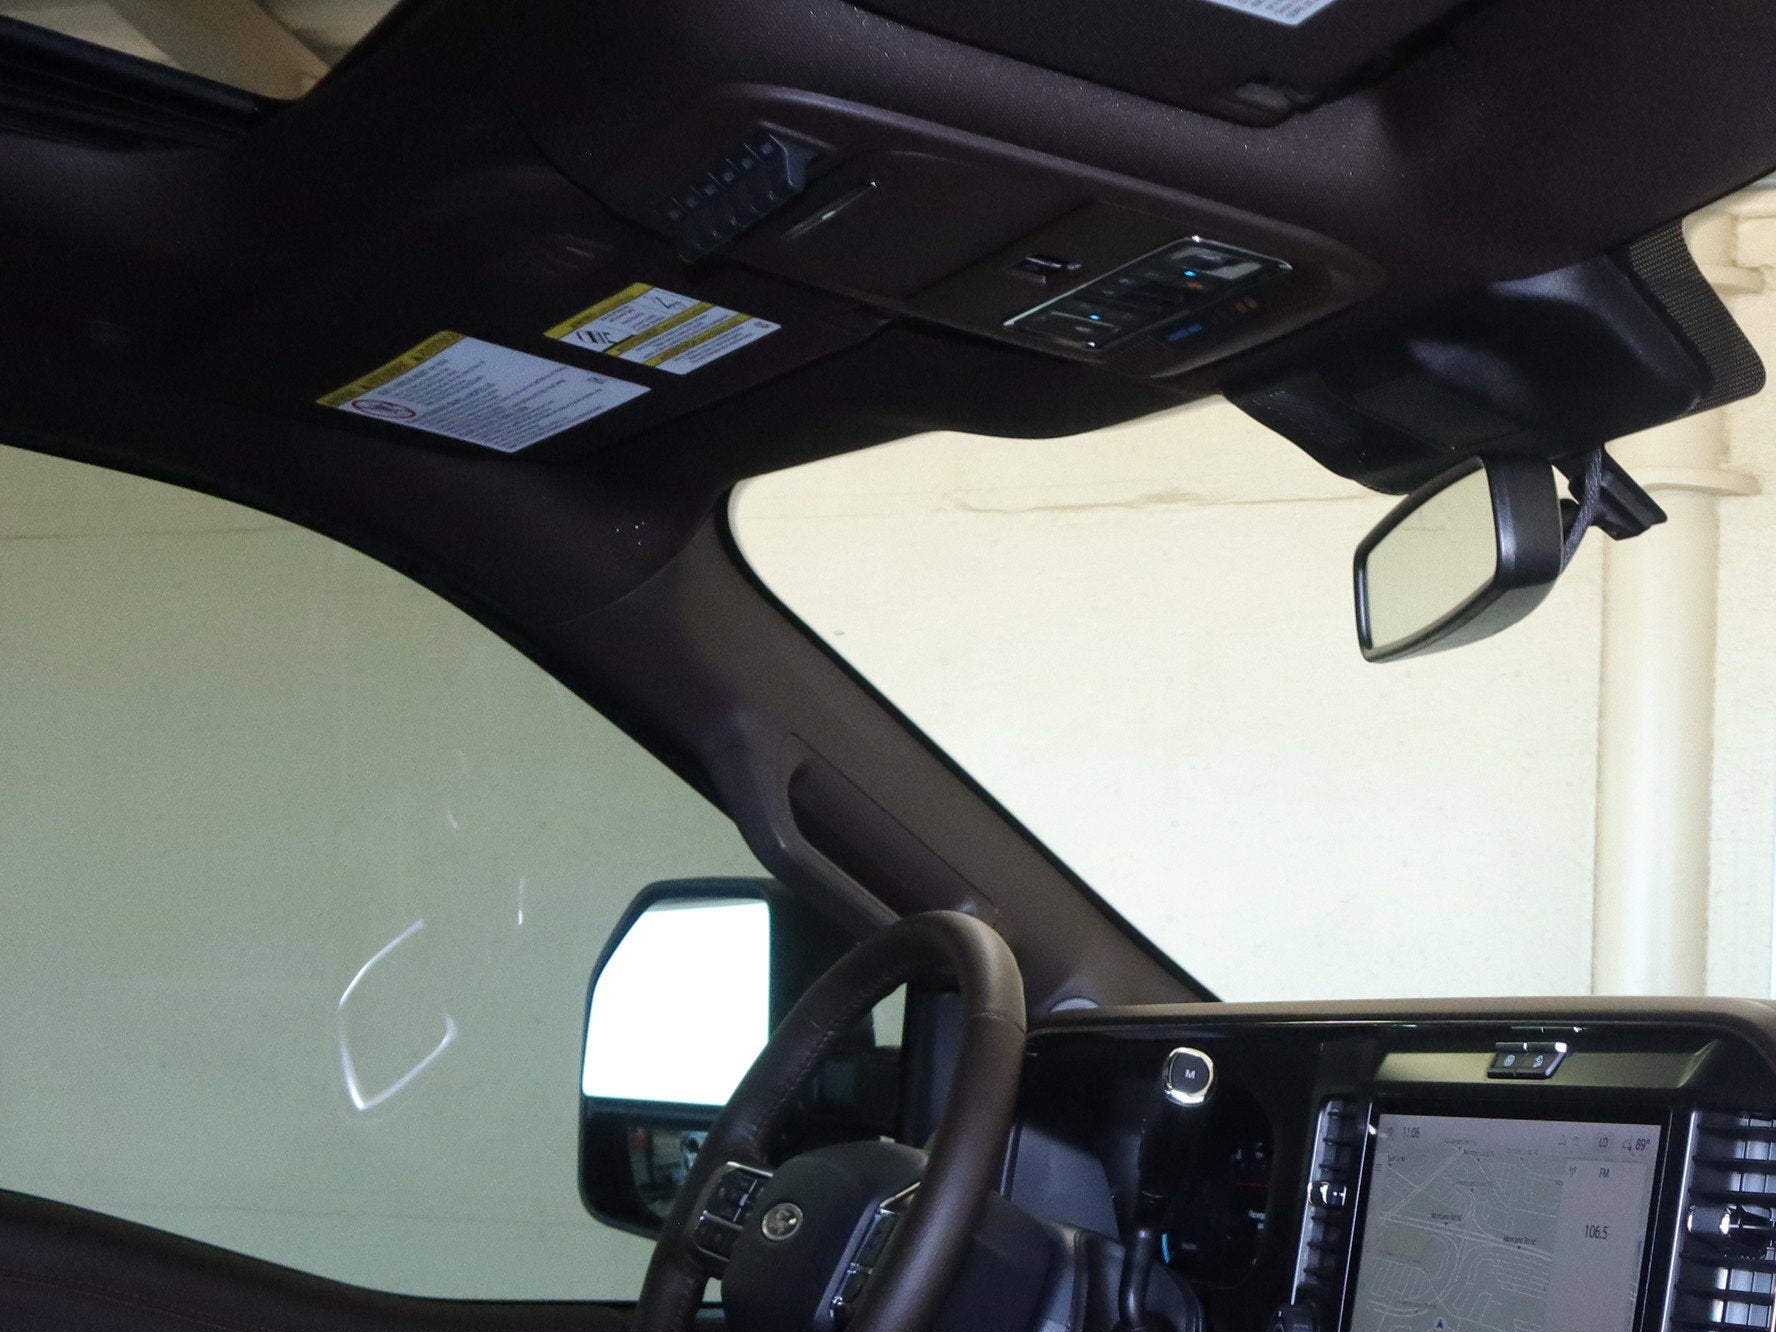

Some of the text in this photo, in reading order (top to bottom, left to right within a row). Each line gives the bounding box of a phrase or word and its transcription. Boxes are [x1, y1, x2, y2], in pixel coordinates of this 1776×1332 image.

[1185, 1069, 1196, 1079] M
[1600, 1167, 1610, 1179] FM
[1585, 1224, 1609, 1240] 106.5
